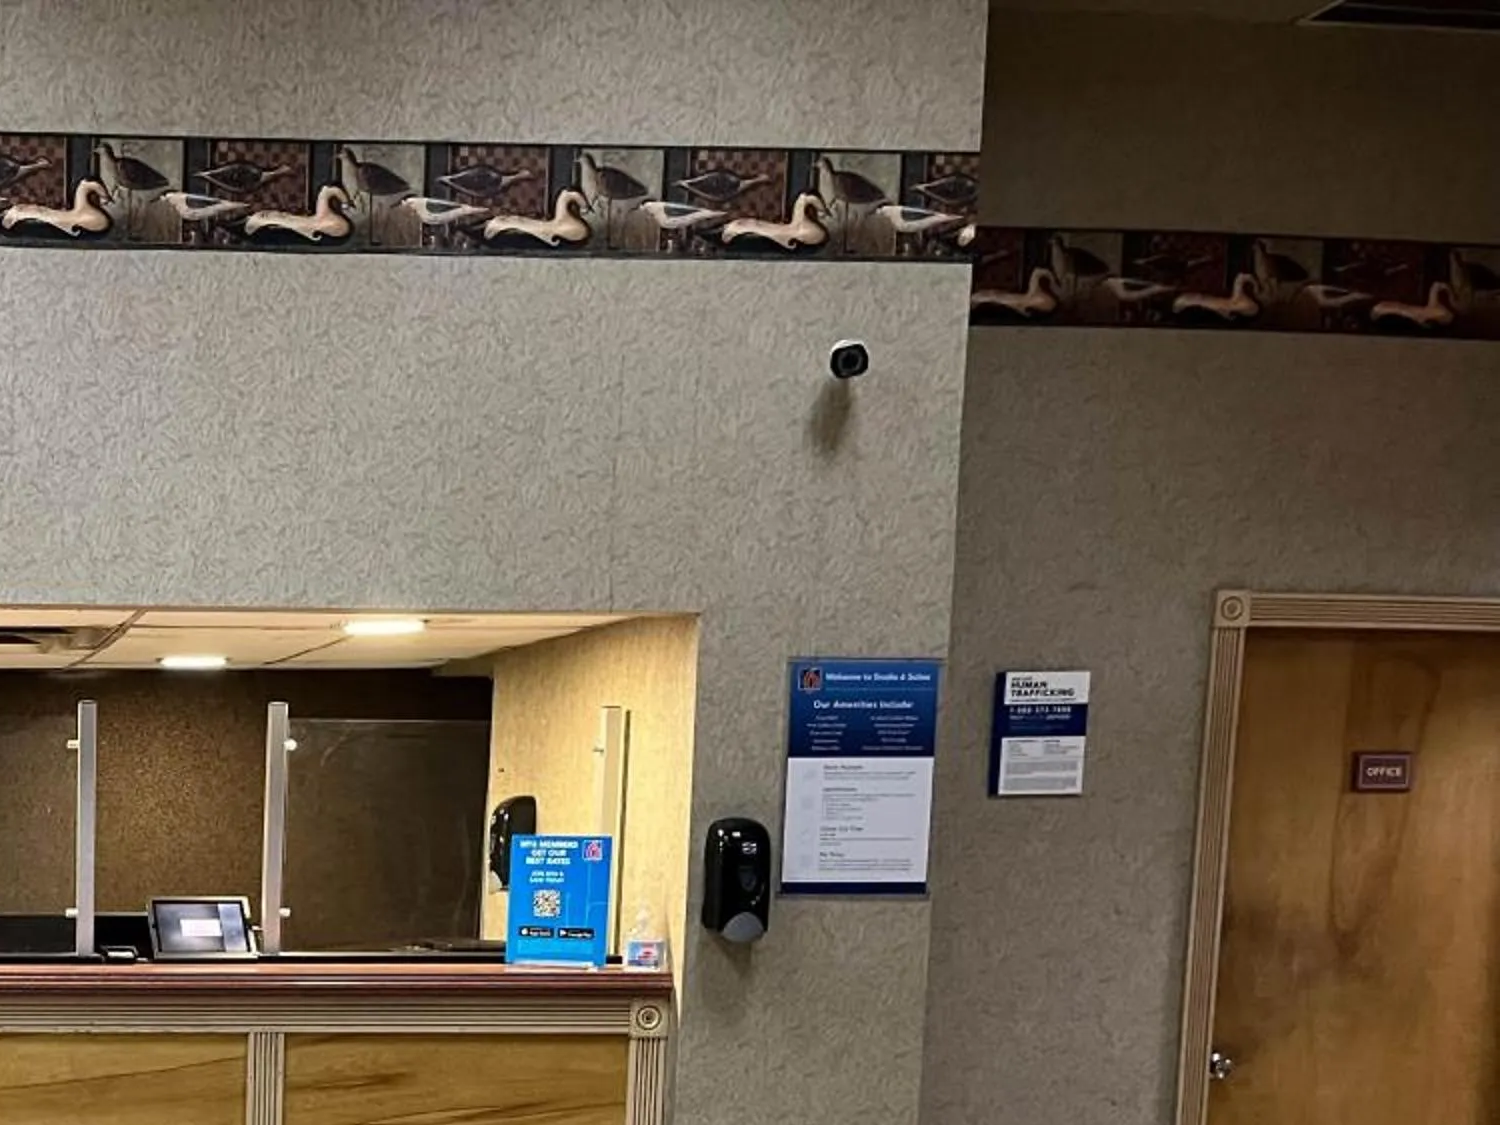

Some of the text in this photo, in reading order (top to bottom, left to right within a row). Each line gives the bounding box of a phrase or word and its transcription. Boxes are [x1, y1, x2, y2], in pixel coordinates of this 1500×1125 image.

[1011, 681, 1048, 689] HUMAN
[1011, 688, 1075, 697] TRAFFICKING
[813, 700, 830, 709] Our
[833, 700, 877, 709] Amenities
[1366, 767, 1402, 777] OFFICE
[547, 849, 567, 857] OUR
